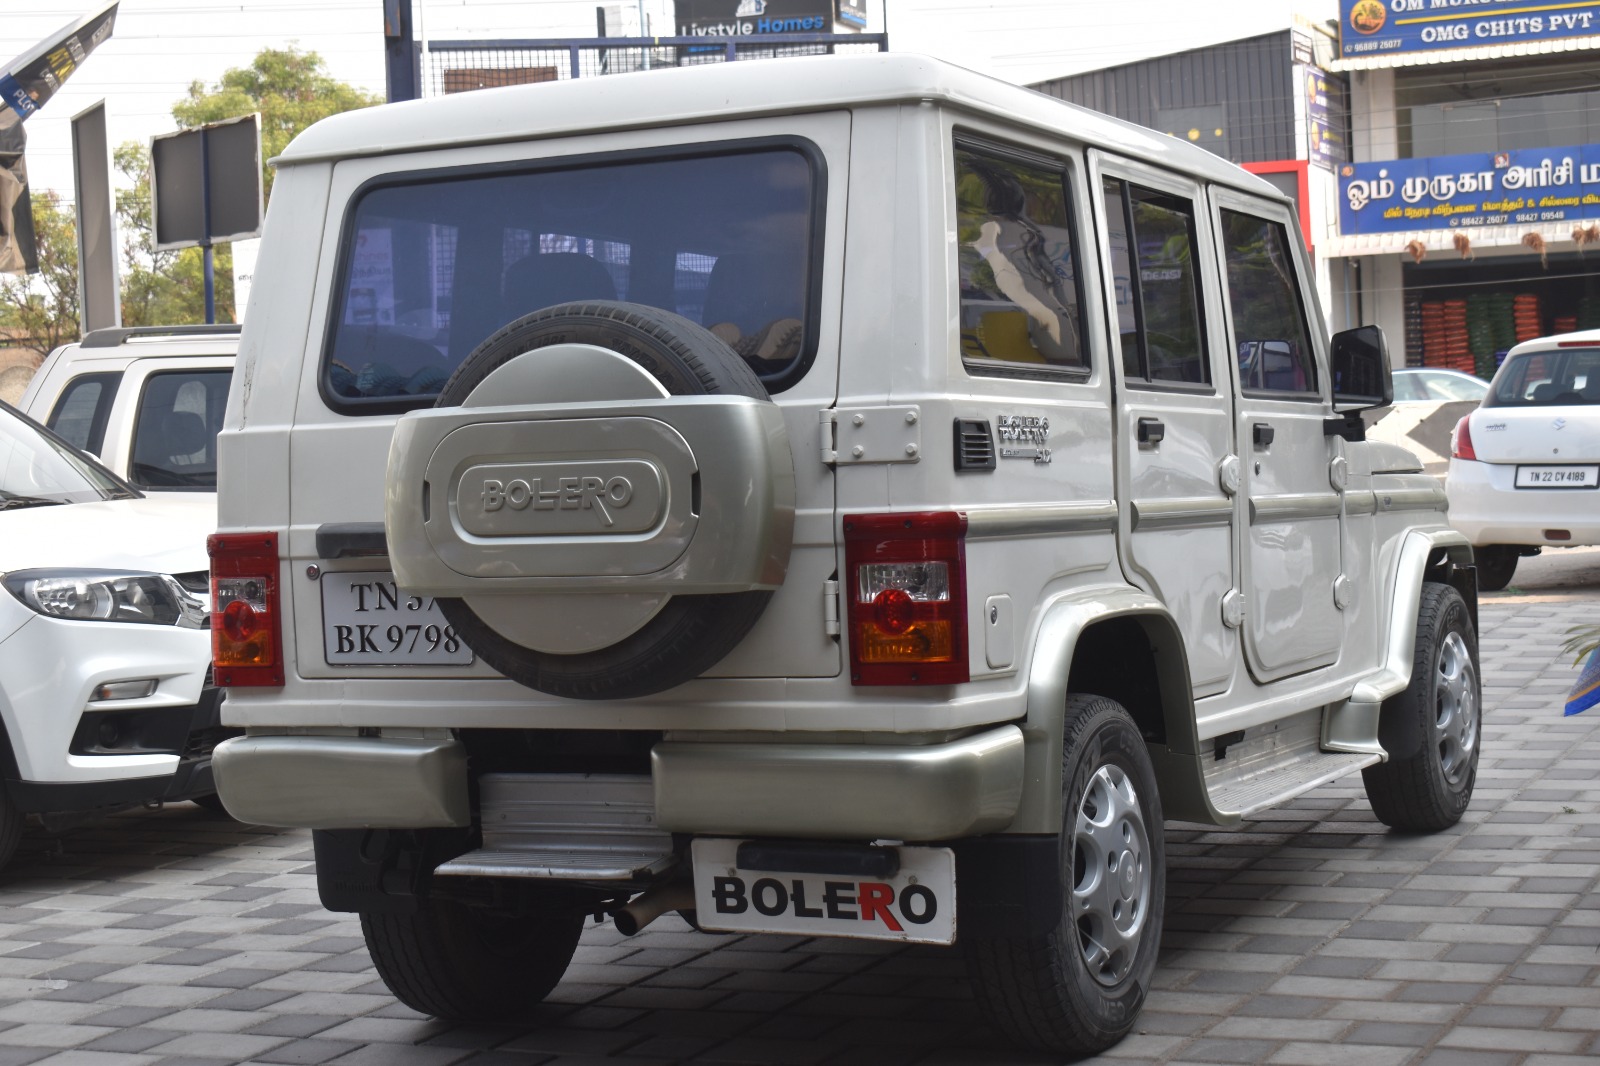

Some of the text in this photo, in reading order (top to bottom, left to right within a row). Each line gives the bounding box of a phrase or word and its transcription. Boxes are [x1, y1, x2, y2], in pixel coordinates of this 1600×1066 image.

[757, 15, 824, 34] Homes
[1421, 11, 1593, 43] OMG CHITS PVT
[1347, 168, 1395, 210] ஓம்
[1401, 171, 1495, 203] முருகா
[1502, 156, 1573, 189] அரிசி
[1530, 471, 1585, 482] TN 22 CV 4189
[481, 476, 633, 527] BOLERO
[350, 581, 398, 612] TN
[712, 876, 937, 931] BOLERO
